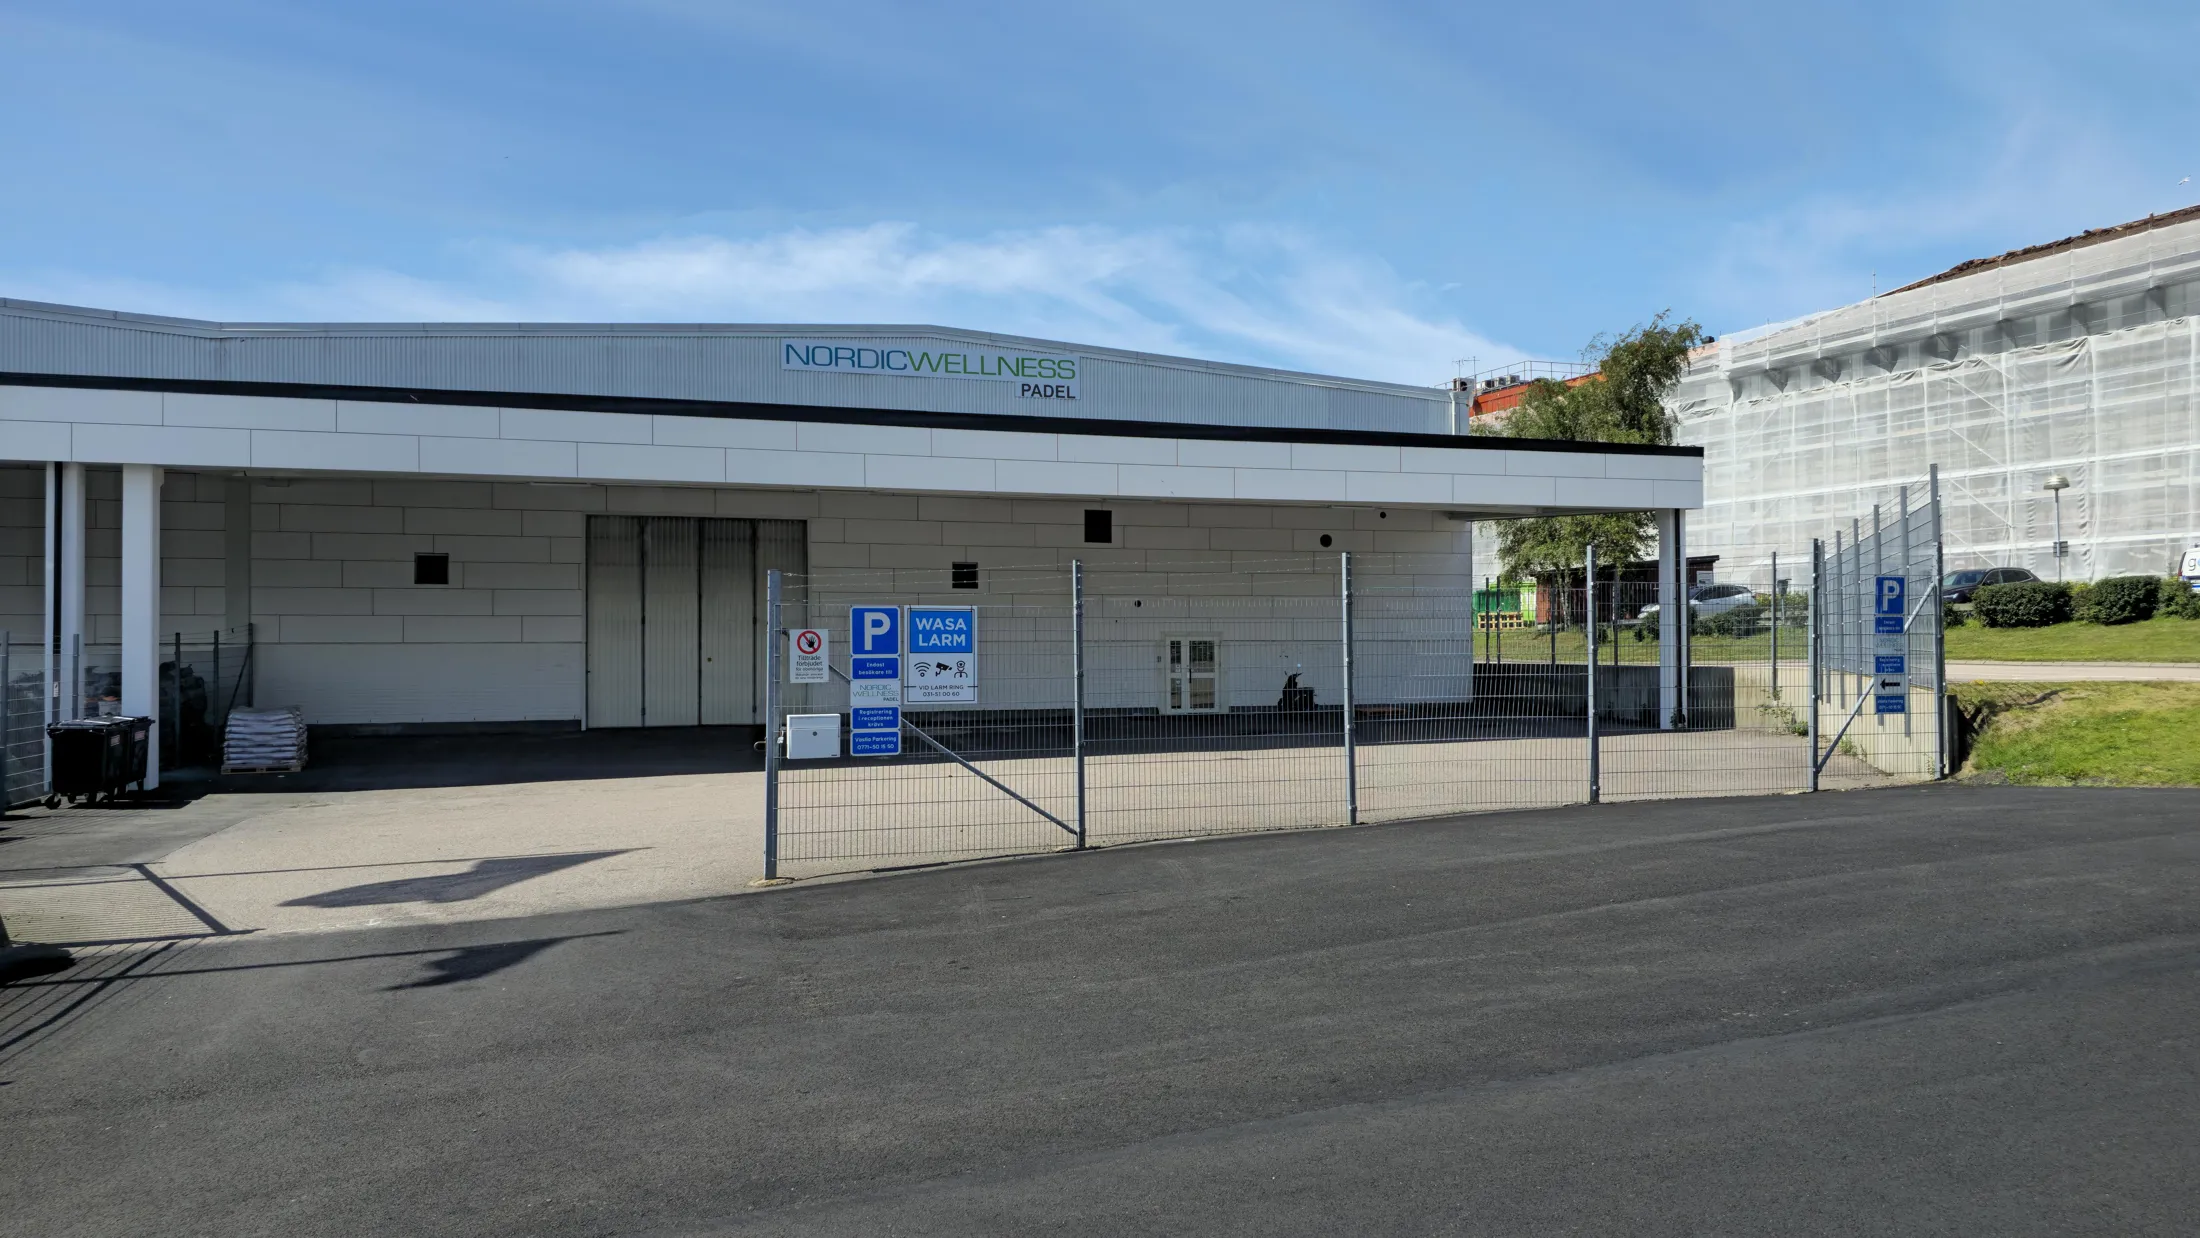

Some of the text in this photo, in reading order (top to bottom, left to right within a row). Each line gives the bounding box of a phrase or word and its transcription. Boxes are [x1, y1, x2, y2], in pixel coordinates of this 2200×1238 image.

[1021, 383, 1077, 399] PADEL
[1883, 580, 1900, 611] P
[864, 612, 891, 651] P
[915, 617, 967, 631] WASA
[918, 633, 966, 647] LARM
[852, 690, 899, 698] WELLNESS
